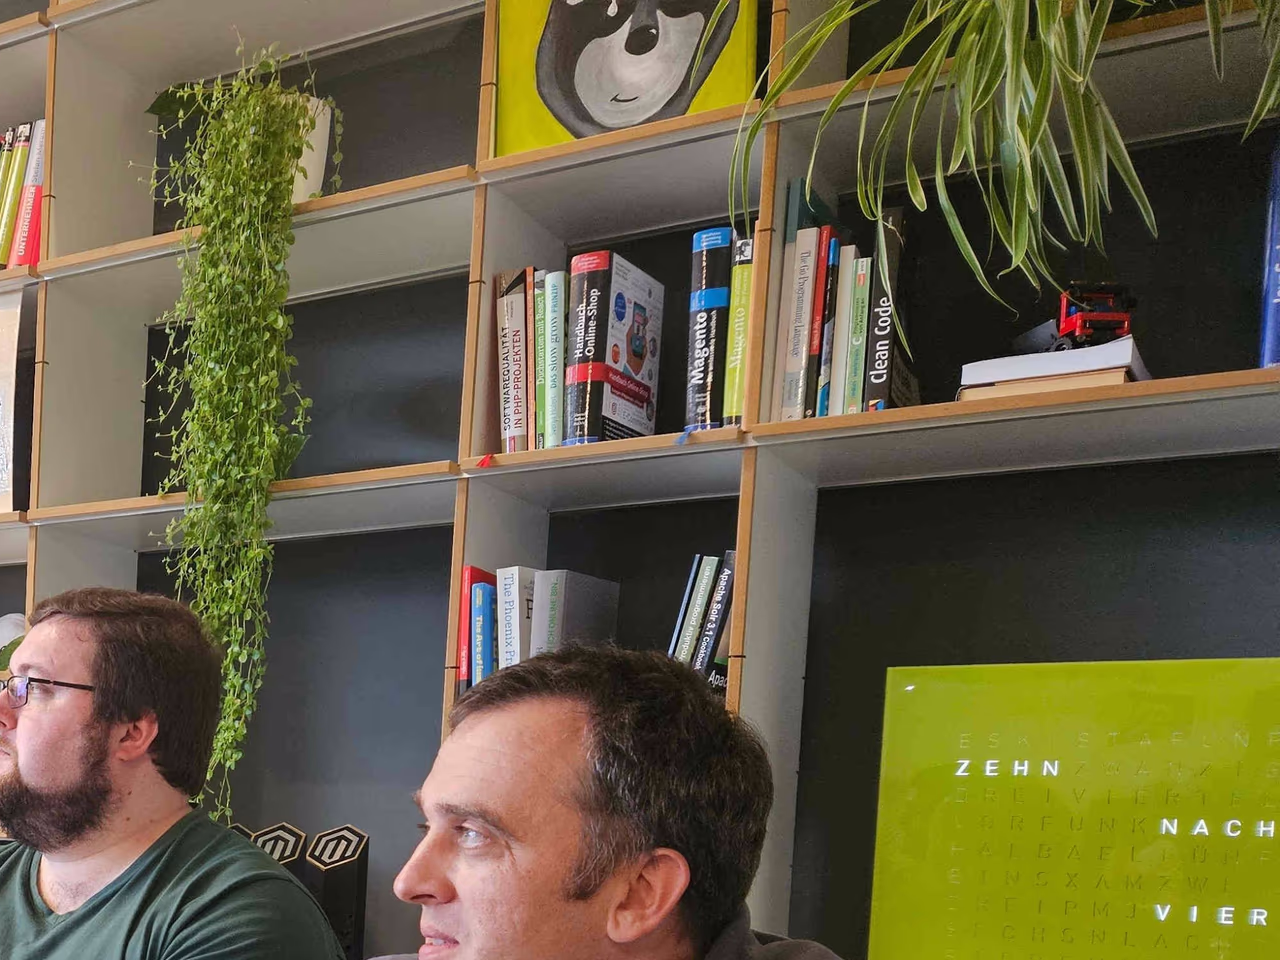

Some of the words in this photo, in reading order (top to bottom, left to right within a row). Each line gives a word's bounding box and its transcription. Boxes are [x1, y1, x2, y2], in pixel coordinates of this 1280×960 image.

[17, 186, 37, 256] UNTERNEHMER
[799, 265, 809, 275] Go
[800, 250, 811, 264] The
[536, 296, 545, 319] React
[793, 277, 809, 325] Programming
[550, 315, 560, 343] grow
[584, 288, 601, 357] Online-Shop
[709, 310, 717, 338] Handbuch
[874, 297, 893, 335] Code
[574, 303, 587, 358] Handbuch
[729, 308, 746, 369] Magento
[790, 325, 804, 358] Language
[851, 336, 862, 346] C
[549, 346, 557, 372] slow
[690, 311, 709, 385] Magento
[512, 329, 522, 415] PHP-PROJEKTEN
[870, 341, 888, 384] Clean
[501, 326, 511, 431] SOFTWAREQUALITÄT
[513, 418, 522, 429] IN
[504, 573, 515, 597] The
[690, 565, 711, 625] programmieren
[716, 568, 732, 601] Apache
[475, 615, 484, 633] The
[504, 600, 515, 647] Phoenix
[711, 602, 722, 621] Solr
[705, 622, 716, 635] 3.1
[475, 634, 484, 652] Art
[694, 637, 710, 670] Cookbook
[955, 759, 1060, 777] ZEHN
[1159, 818, 1276, 838] NACH
[1154, 904, 1268, 926] VIER
